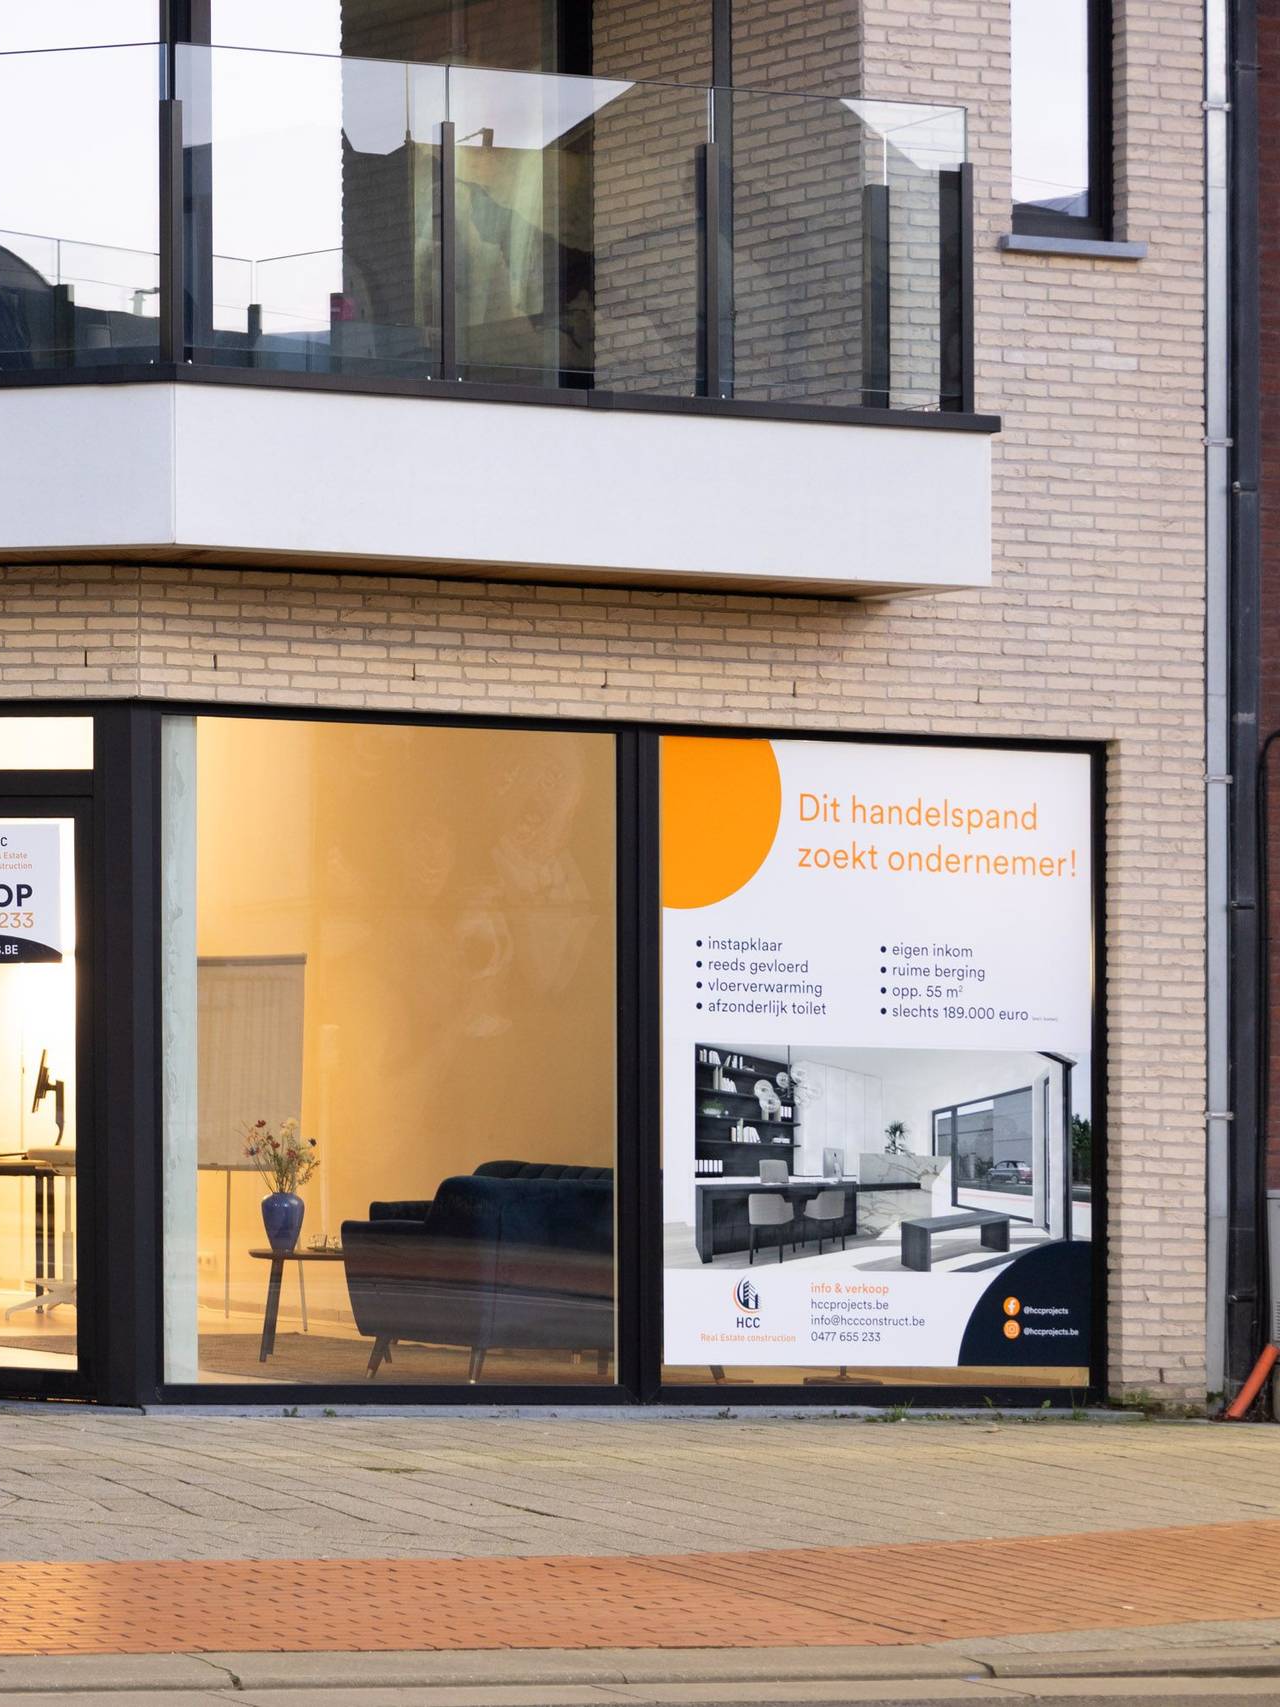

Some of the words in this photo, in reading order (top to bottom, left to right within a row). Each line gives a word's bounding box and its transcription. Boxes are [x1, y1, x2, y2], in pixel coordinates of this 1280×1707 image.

[800, 793, 840, 822] Dit
[852, 795, 1037, 834] handelspand
[3, 851, 28, 860] Estate
[799, 841, 877, 869] zoekt
[888, 845, 1075, 877] ondernemer!
[709, 936, 782, 953] instapklaar
[893, 942, 928, 959] eigen
[933, 944, 972, 957] inkom
[709, 958, 745, 971] reeds
[750, 960, 808, 975] gevloerd
[893, 963, 930, 976] ruime
[935, 964, 985, 982] berging
[708, 978, 822, 997] vloerverwarming
[893, 987, 921, 999] opp.
[927, 986, 942, 997] 55
[947, 985, 963, 997] m²
[709, 999, 787, 1017] afzonderlijk
[792, 1001, 826, 1015] toilet
[893, 1004, 938, 1018] slechts
[943, 1007, 994, 1019] 189.000
[999, 1011, 1028, 1020] euro
[811, 1282, 832, 1293] info
[834, 1284, 843, 1293] &
[845, 1283, 889, 1296] verkoop
[811, 1299, 888, 1312] hccprojects.be
[1024, 1306, 1068, 1315] @hccprojects
[737, 1317, 760, 1328] HCC
[811, 1315, 925, 1326] info@hccconstruct.be
[700, 1333, 718, 1342] Real
[720, 1333, 746, 1342] Estate
[747, 1334, 797, 1342] construction
[811, 1331, 836, 1341] 0477
[840, 1332, 859, 1341] 655
[862, 1332, 880, 1342] 233
[1024, 1328, 1078, 1336] @hccprojects.be
